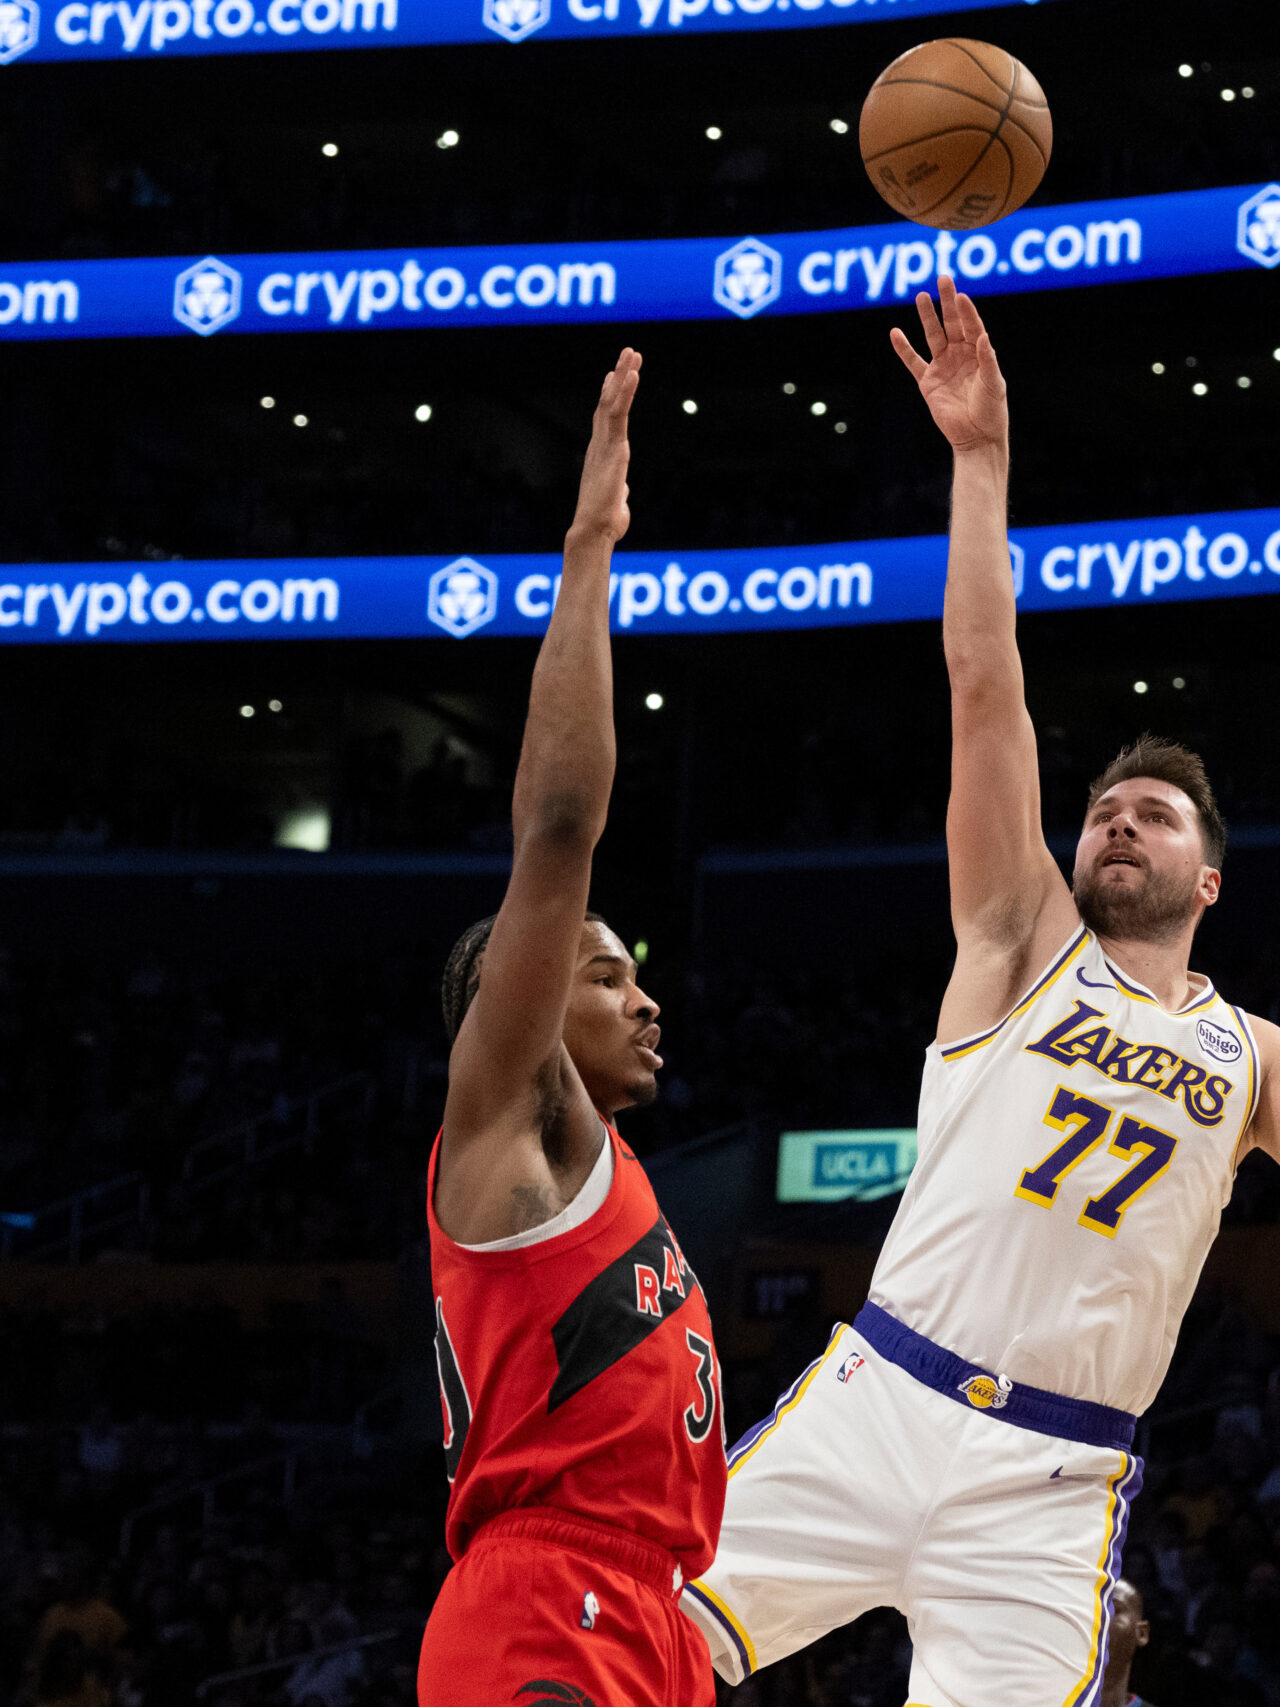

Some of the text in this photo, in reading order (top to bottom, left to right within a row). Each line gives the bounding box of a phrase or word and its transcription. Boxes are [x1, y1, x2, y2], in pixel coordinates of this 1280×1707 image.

[54, 0, 399, 51] crypto.com
[258, 257, 616, 322] crypto.com
[798, 218, 1142, 298] crypto.com
[515, 562, 873, 627] cpto.com
[1022, 999, 1235, 1129] LAKERS
[1199, 1024, 1239, 1054] bibigo
[821, 1149, 889, 1180] UCLA
[1013, 1083, 1180, 1239] 77
[683, 1326, 727, 1444] 3
